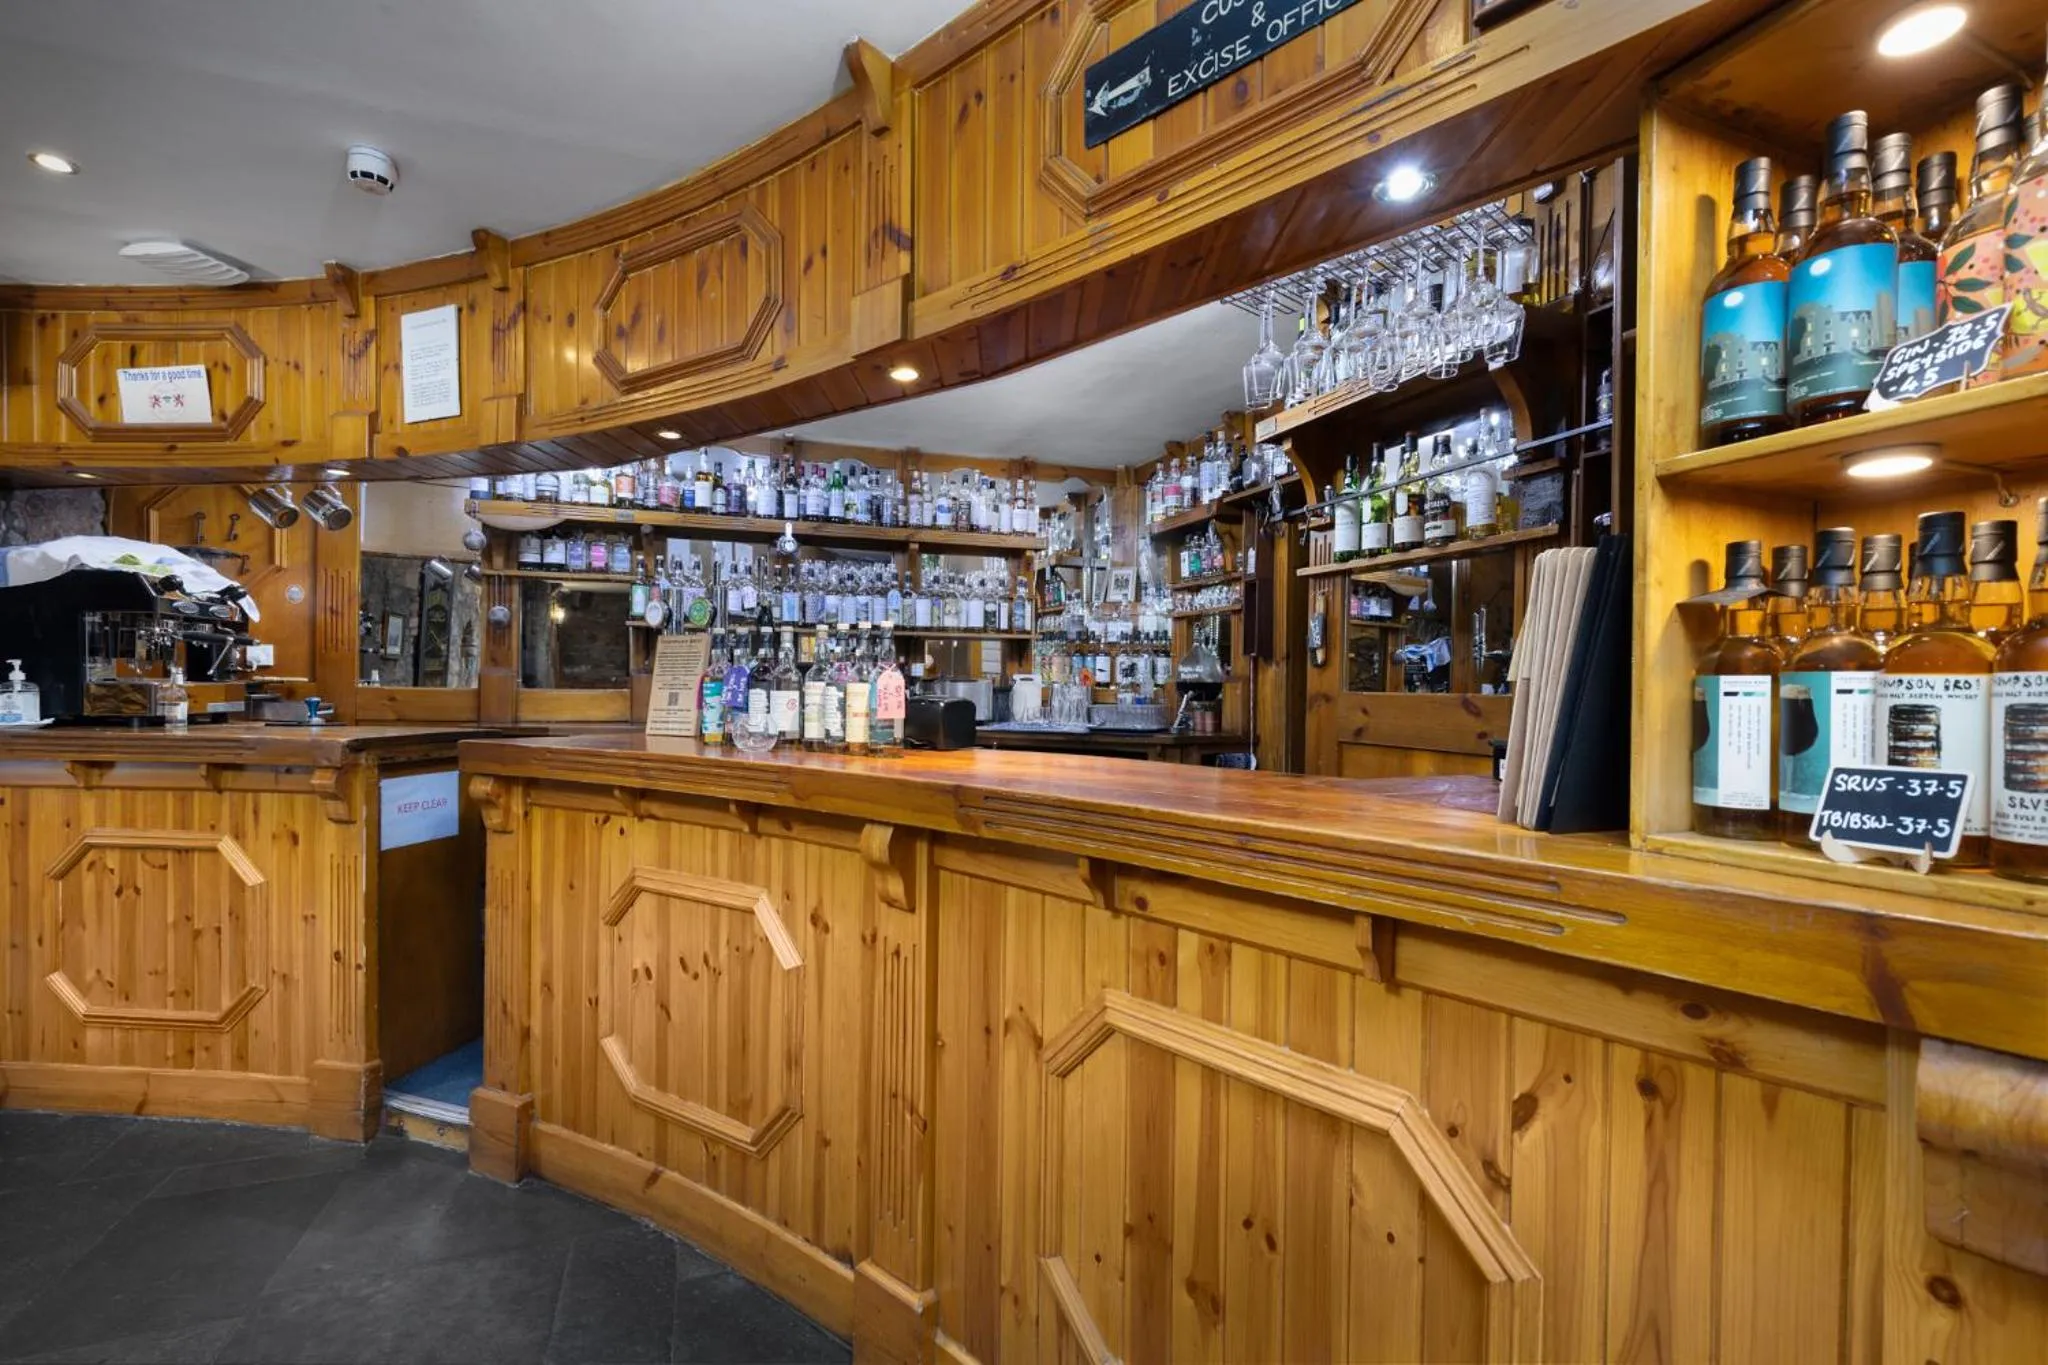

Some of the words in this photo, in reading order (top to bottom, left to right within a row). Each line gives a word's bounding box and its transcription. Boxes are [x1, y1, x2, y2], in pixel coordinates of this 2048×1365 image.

[1251, 1, 1266, 27] &
[1168, 35, 1251, 97] EXCISE
[1883, 334, 1988, 382] SPEYSIDE
[1892, 339, 1930, 364] GIN
[123, 371, 149, 381] Thanks
[149, 371, 160, 381] for
[168, 370, 186, 383] good
[397, 801, 420, 816] KEEP
[421, 797, 448, 810] CLEAR
